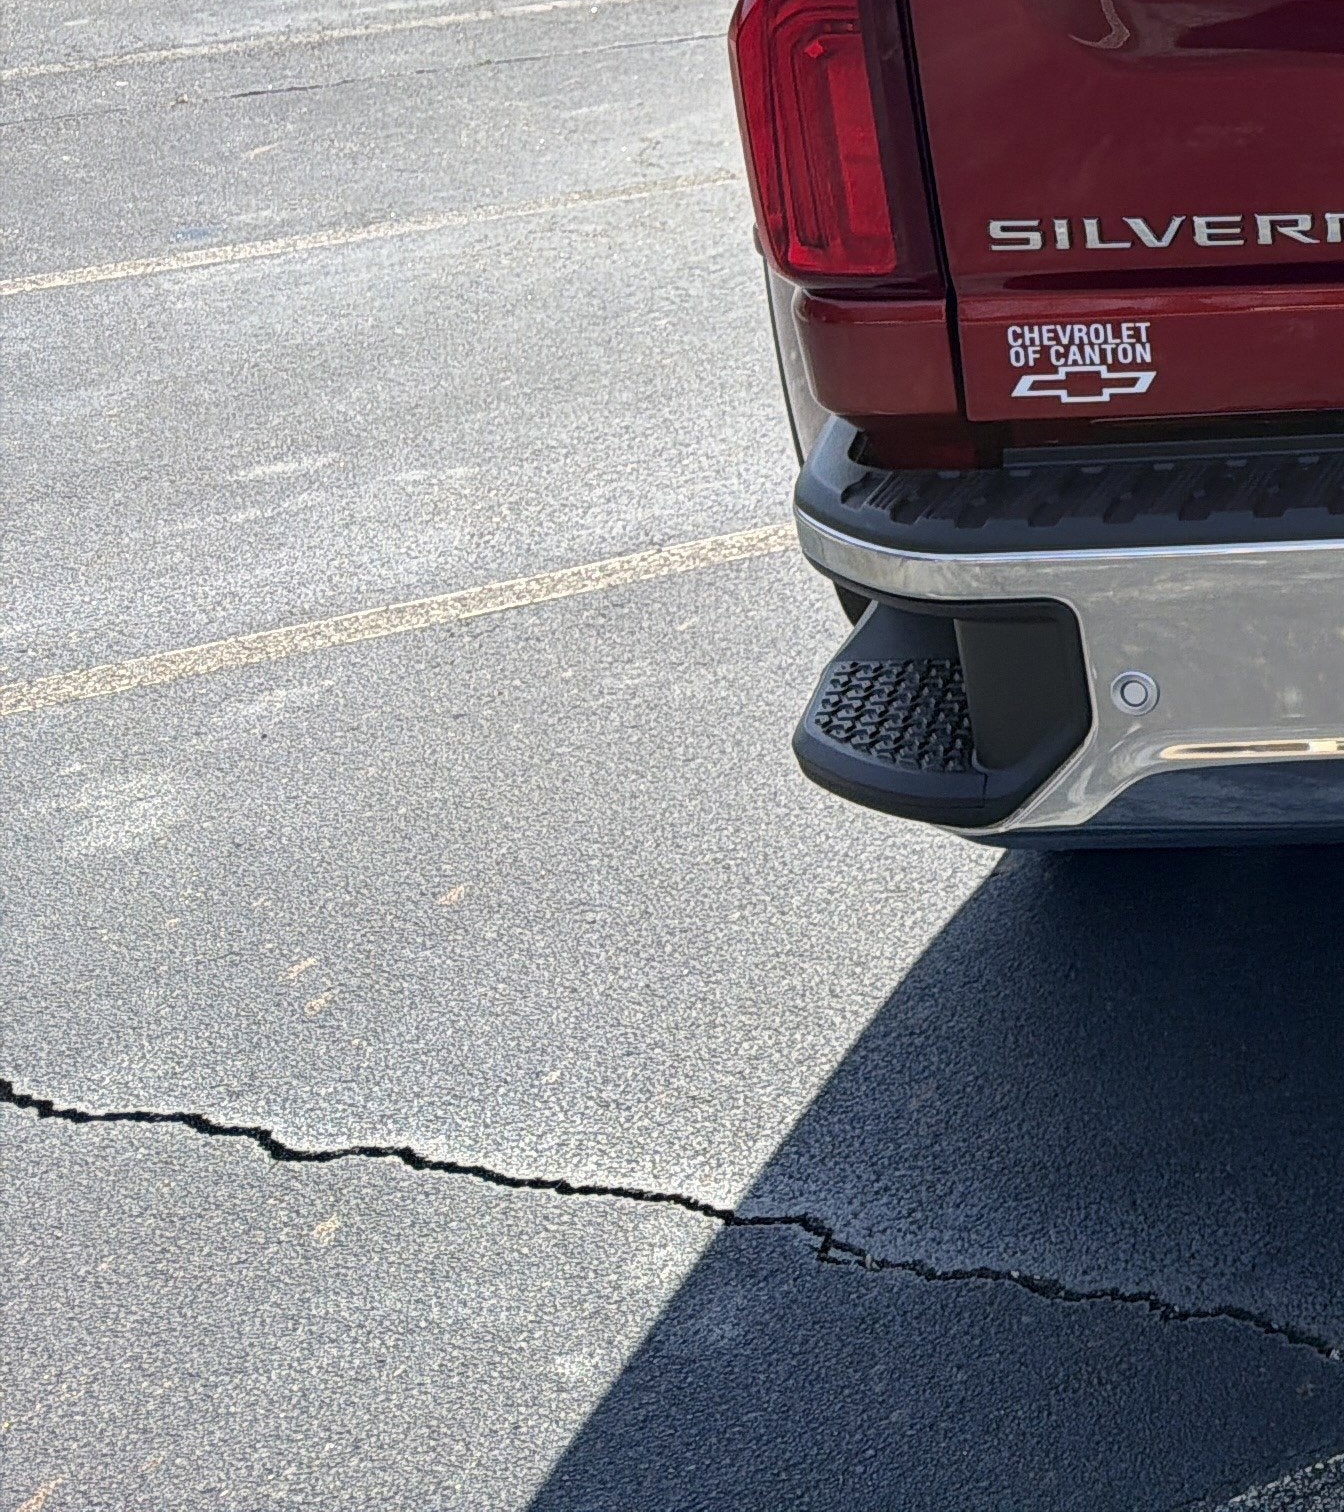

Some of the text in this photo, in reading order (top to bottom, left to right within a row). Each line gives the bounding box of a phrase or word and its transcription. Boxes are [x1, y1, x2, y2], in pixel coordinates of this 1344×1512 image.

[1006, 321, 1151, 348] CHEVROLET
[1009, 341, 1153, 368] OF CANTON
